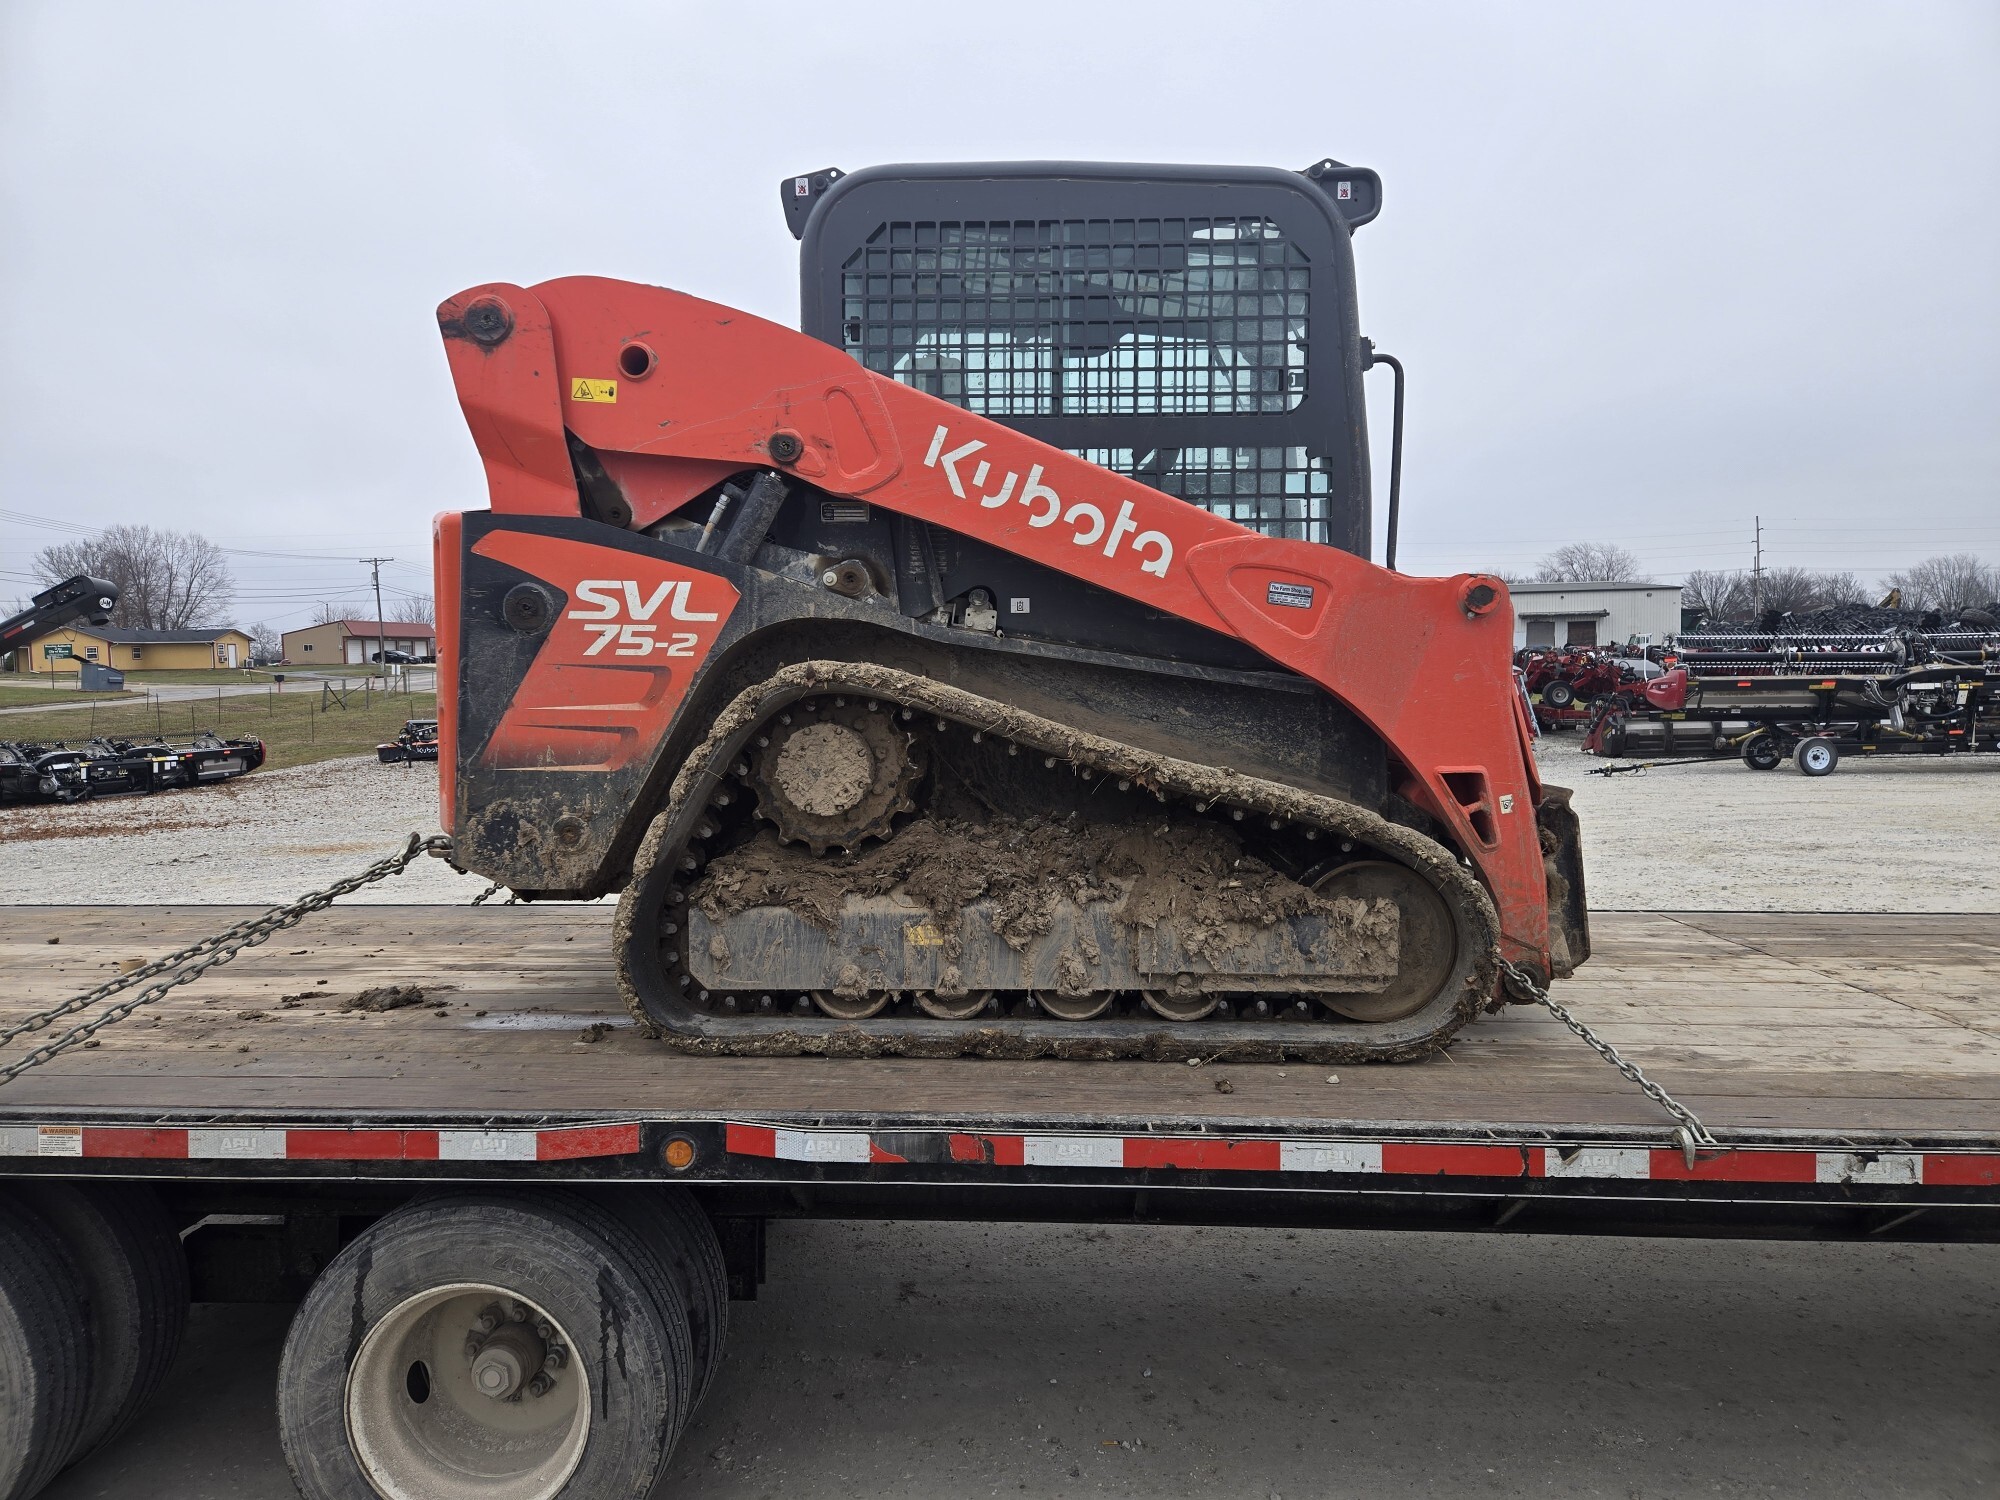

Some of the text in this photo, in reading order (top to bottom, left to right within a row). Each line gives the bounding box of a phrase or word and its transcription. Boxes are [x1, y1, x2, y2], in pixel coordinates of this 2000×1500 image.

[924, 424, 1173, 578] Kubota
[567, 579, 719, 622] SVL
[582, 623, 698, 657] 75-2
